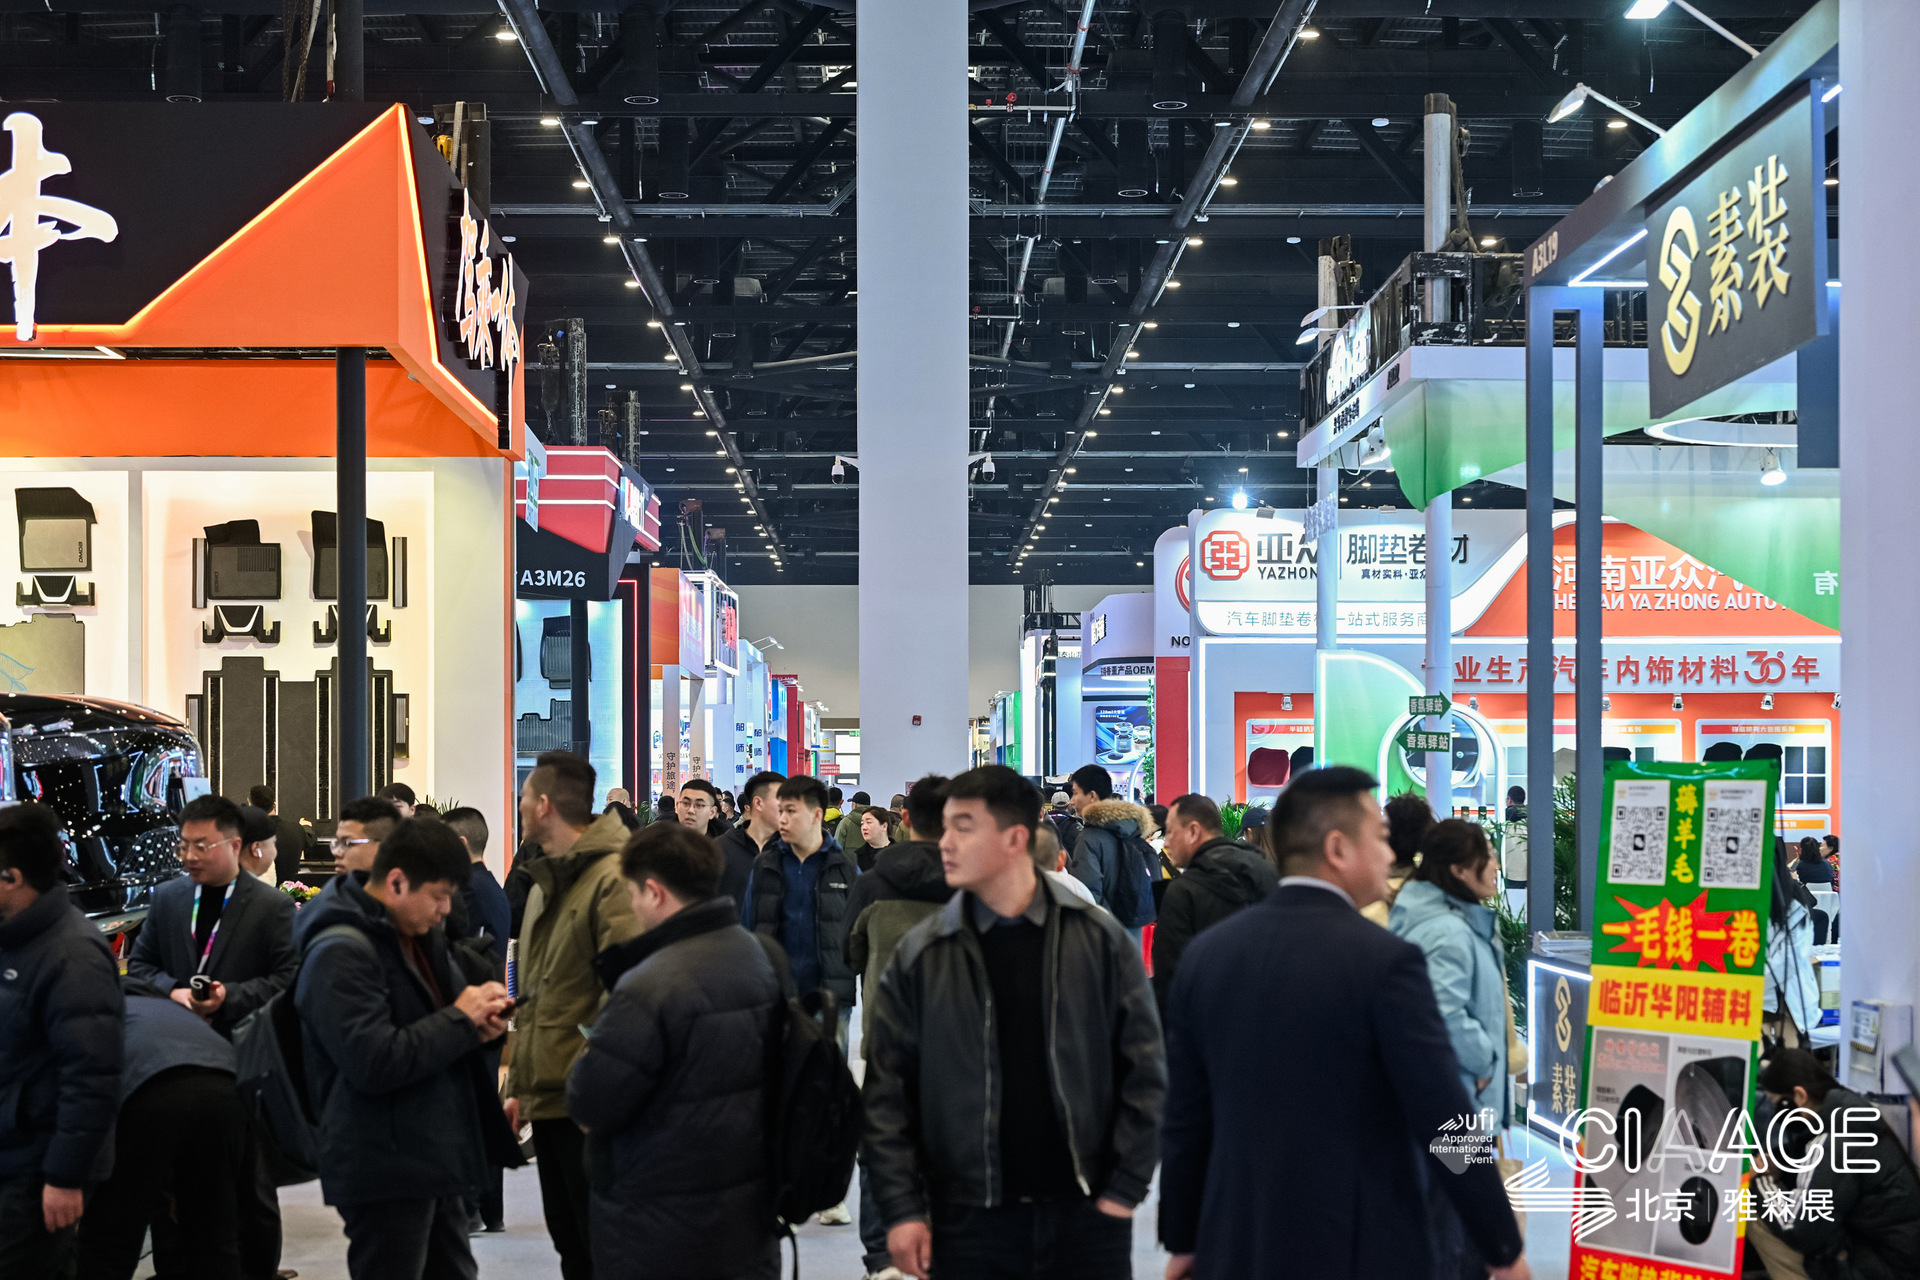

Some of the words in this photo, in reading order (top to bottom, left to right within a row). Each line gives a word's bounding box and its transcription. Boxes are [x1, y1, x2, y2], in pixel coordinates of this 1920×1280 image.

[1531, 231, 1558, 277] A3L19
[1706, 155, 1790, 336] 素装
[520, 569, 586, 588] A3M26
[1257, 566, 1318, 580] YAZHON
[1554, 593, 1625, 611] HEAN
[1628, 593, 1721, 611] YAZHONG
[1227, 610, 1427, 627] 汽车脚垫卷一站式服务商
[1171, 636, 1191, 647] NO
[1409, 697, 1443, 713] 香氛驿站
[1405, 733, 1449, 750] 香氛驿站
[1601, 906, 1761, 968] 一毛钱一卷
[1598, 978, 1752, 1027] 临沂华阳辅料
